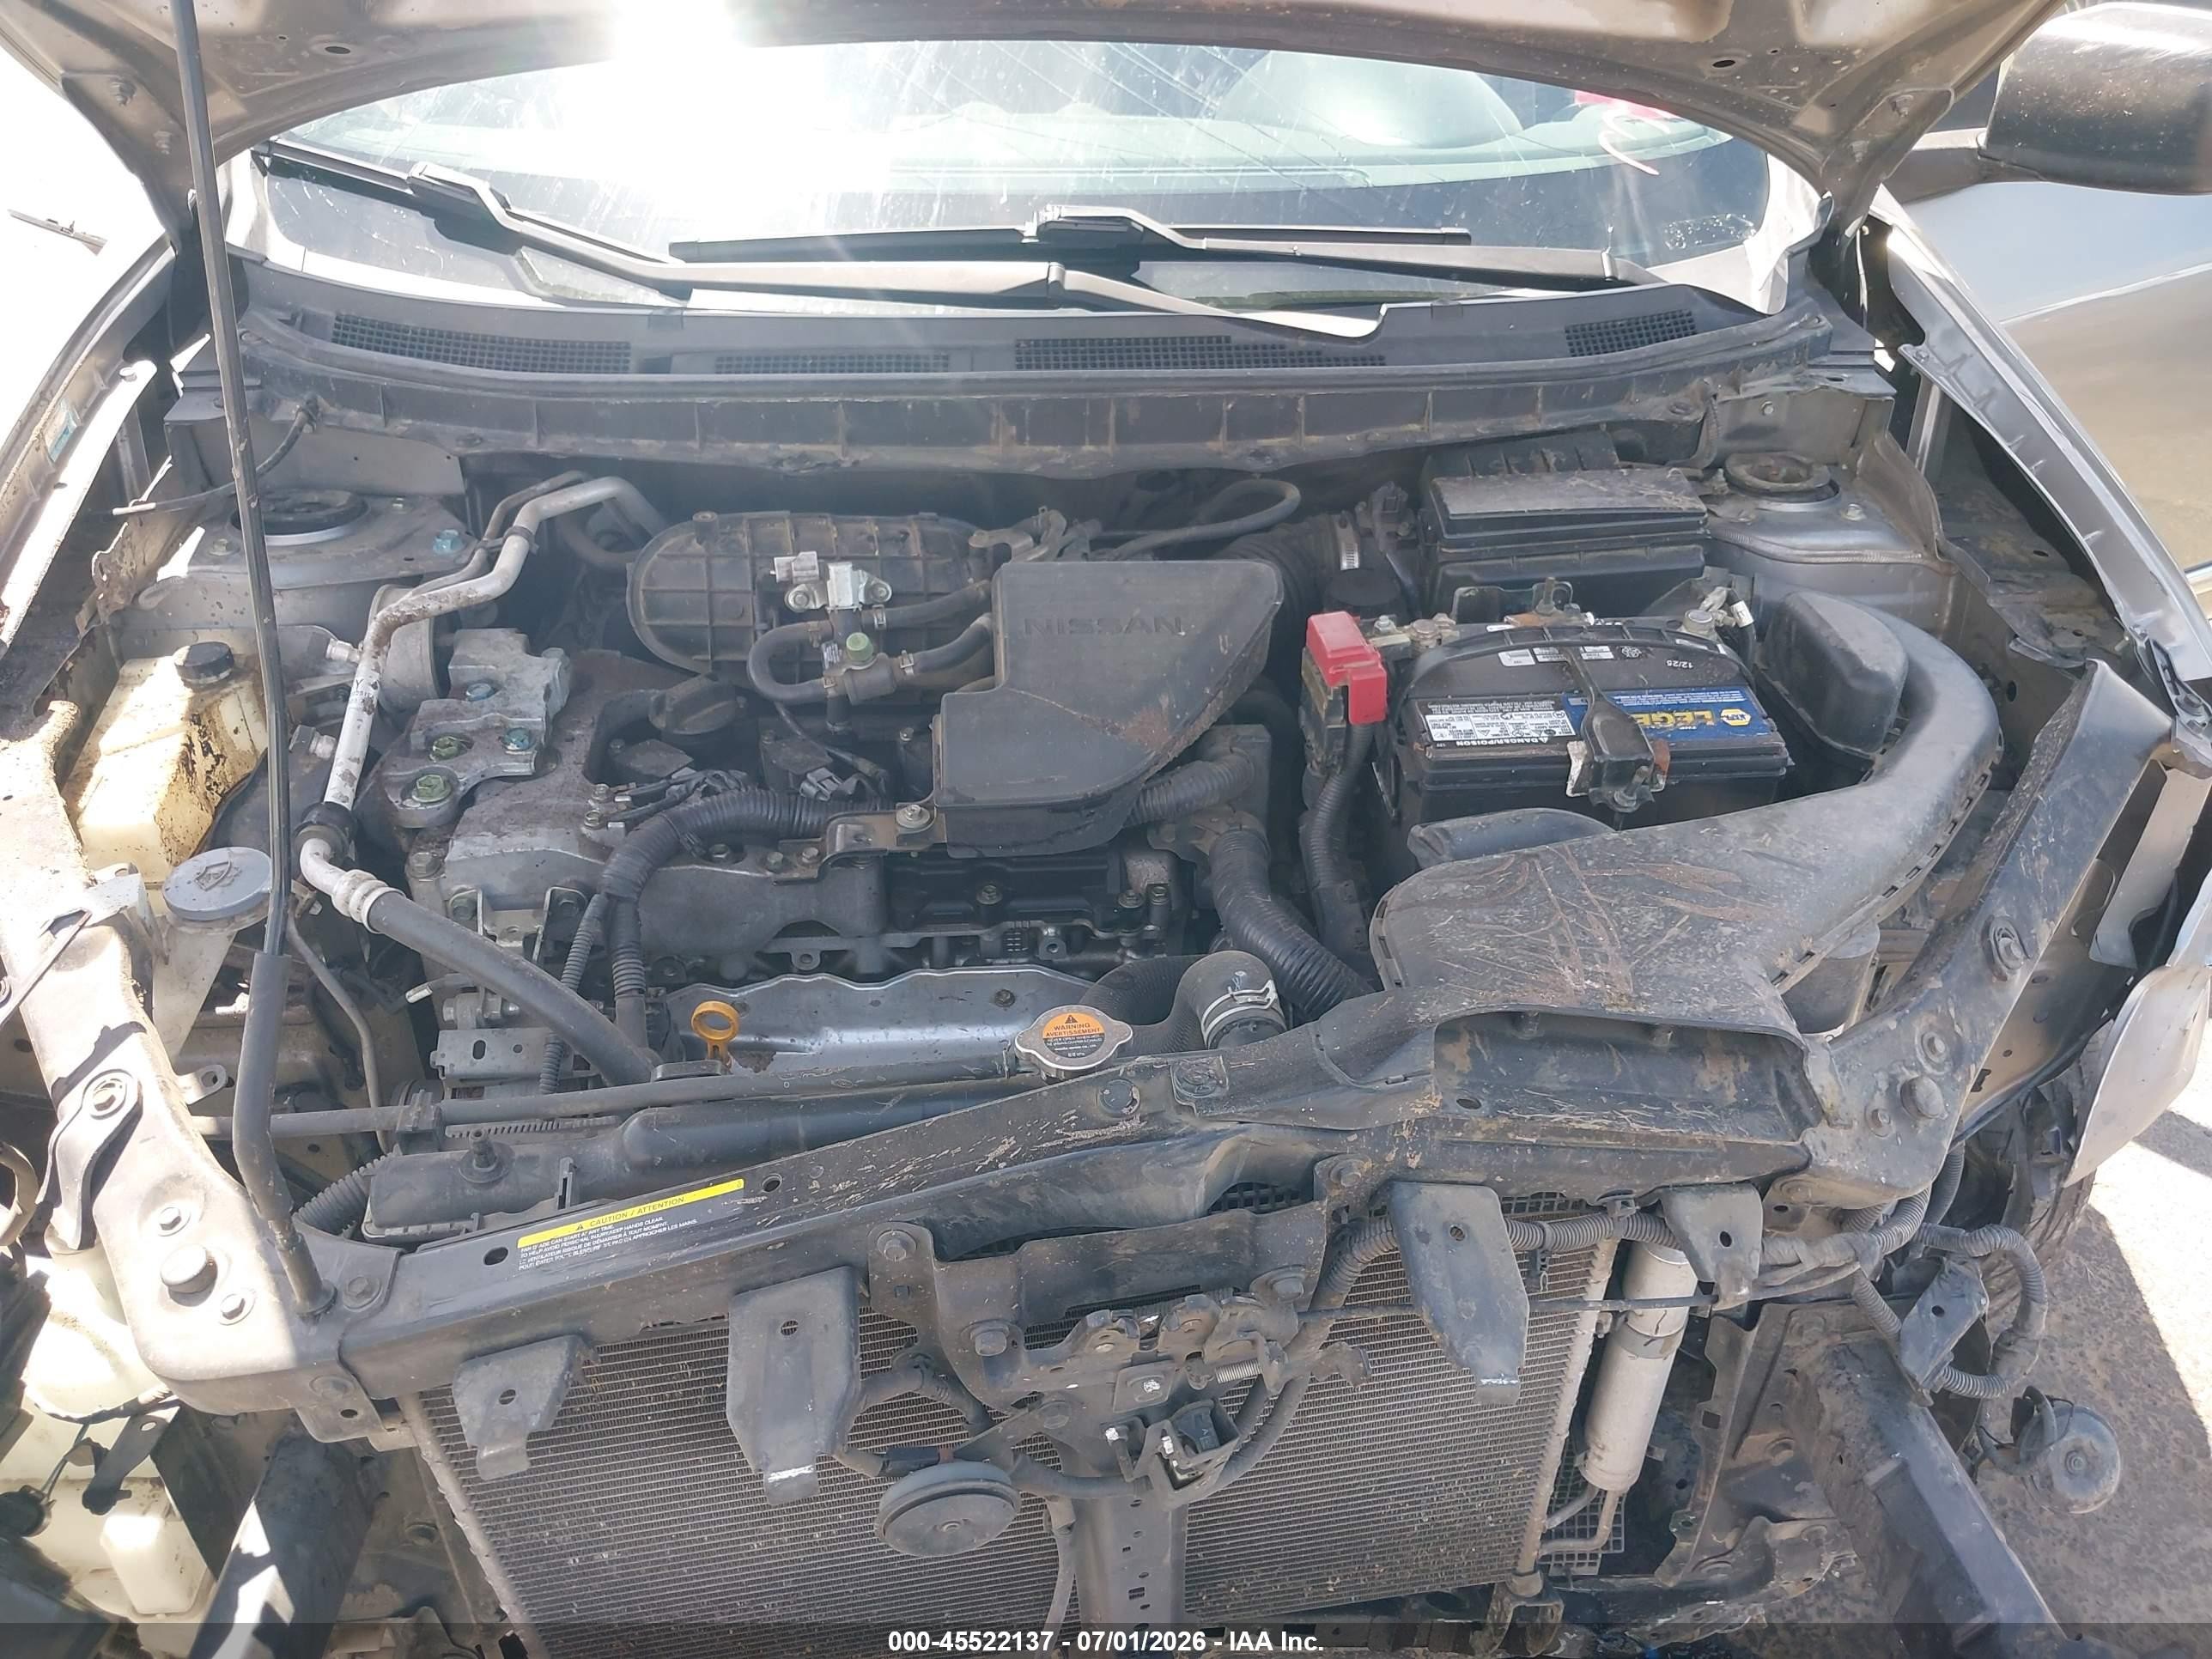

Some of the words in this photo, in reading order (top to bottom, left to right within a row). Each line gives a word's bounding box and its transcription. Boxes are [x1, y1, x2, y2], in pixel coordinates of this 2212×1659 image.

[1024, 617, 1182, 635] NISSAN
[1667, 659, 1693, 669] 12/25
[1046, 1028, 1101, 1036] AVERTISSEMENT
[589, 1212, 628, 1226] CAUTION
[636, 1196, 685, 1214] ATTENTION
[623, 1221, 643, 1230] HANDS
